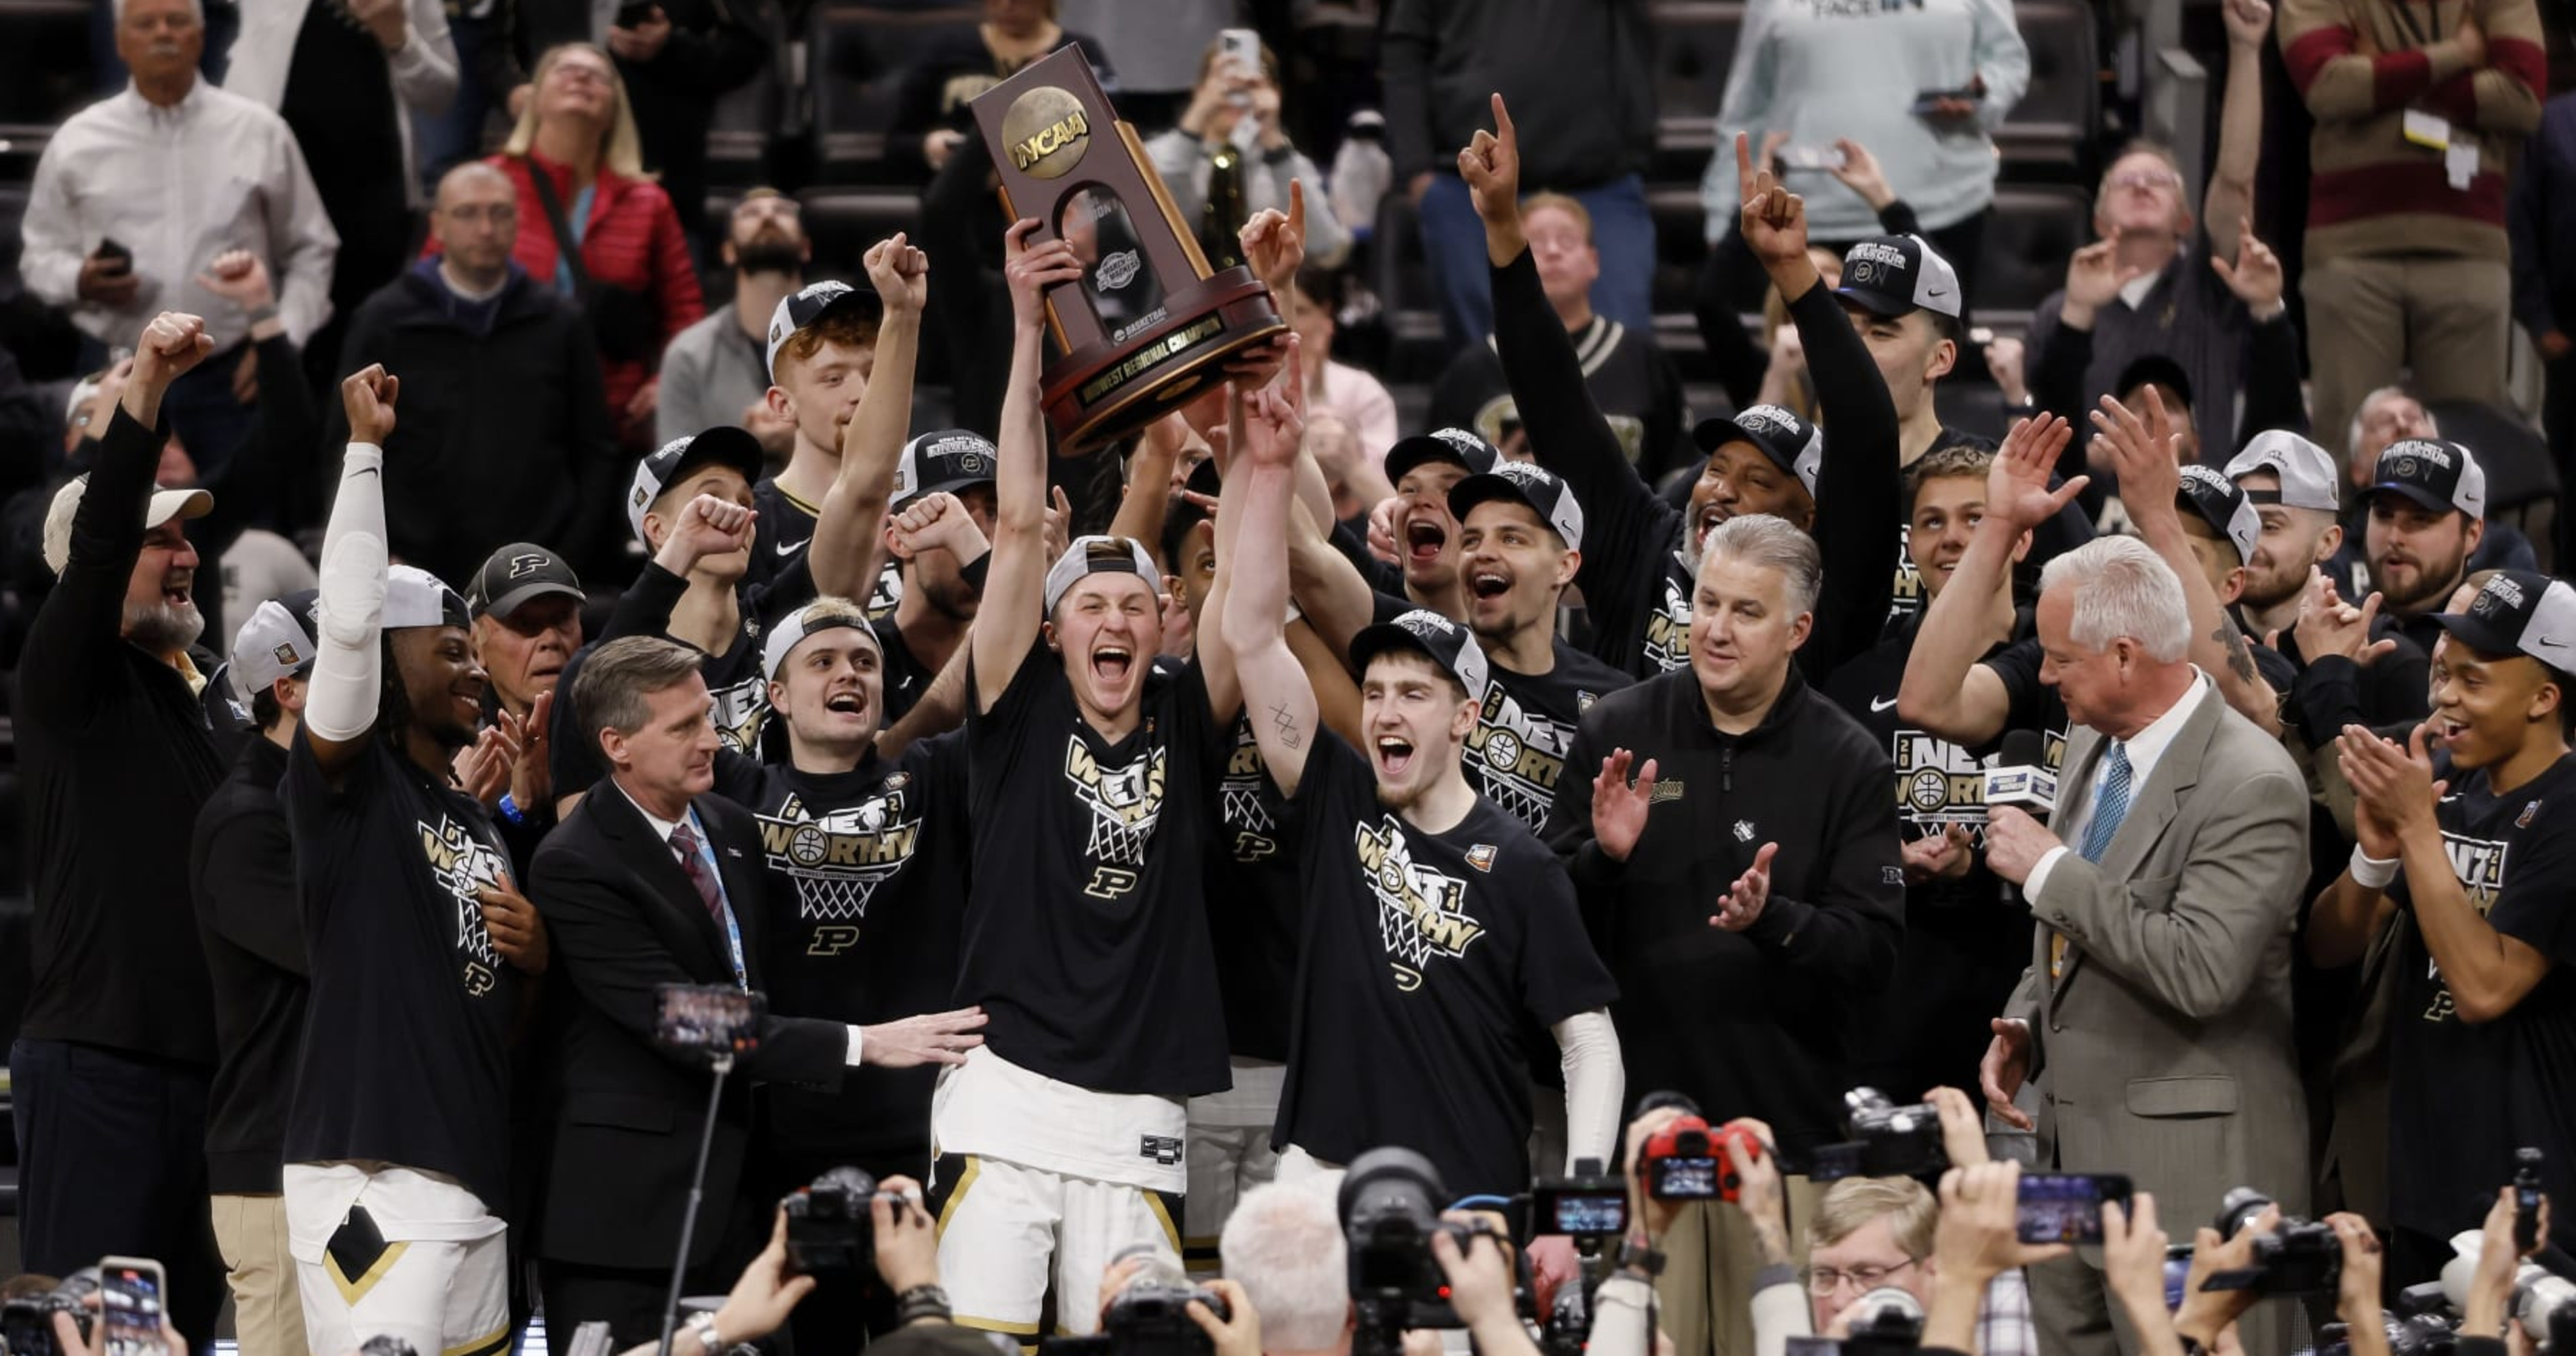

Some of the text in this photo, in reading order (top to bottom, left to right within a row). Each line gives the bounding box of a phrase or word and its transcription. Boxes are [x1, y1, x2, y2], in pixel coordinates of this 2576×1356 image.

[1015, 111, 1088, 170] NCAA
[1123, 342, 1170, 376] REGIONAL
[1167, 316, 1222, 353] CHAMPION
[510, 553, 550, 579] P
[1468, 724, 1563, 789] WORT
[1899, 737, 1986, 773] 20 NE
[1895, 775, 1985, 805] WORT
[758, 819, 915, 866] WORTHY
[1085, 865, 1138, 900] P
[2488, 850, 2500, 880] 24
[807, 925, 860, 955] P
